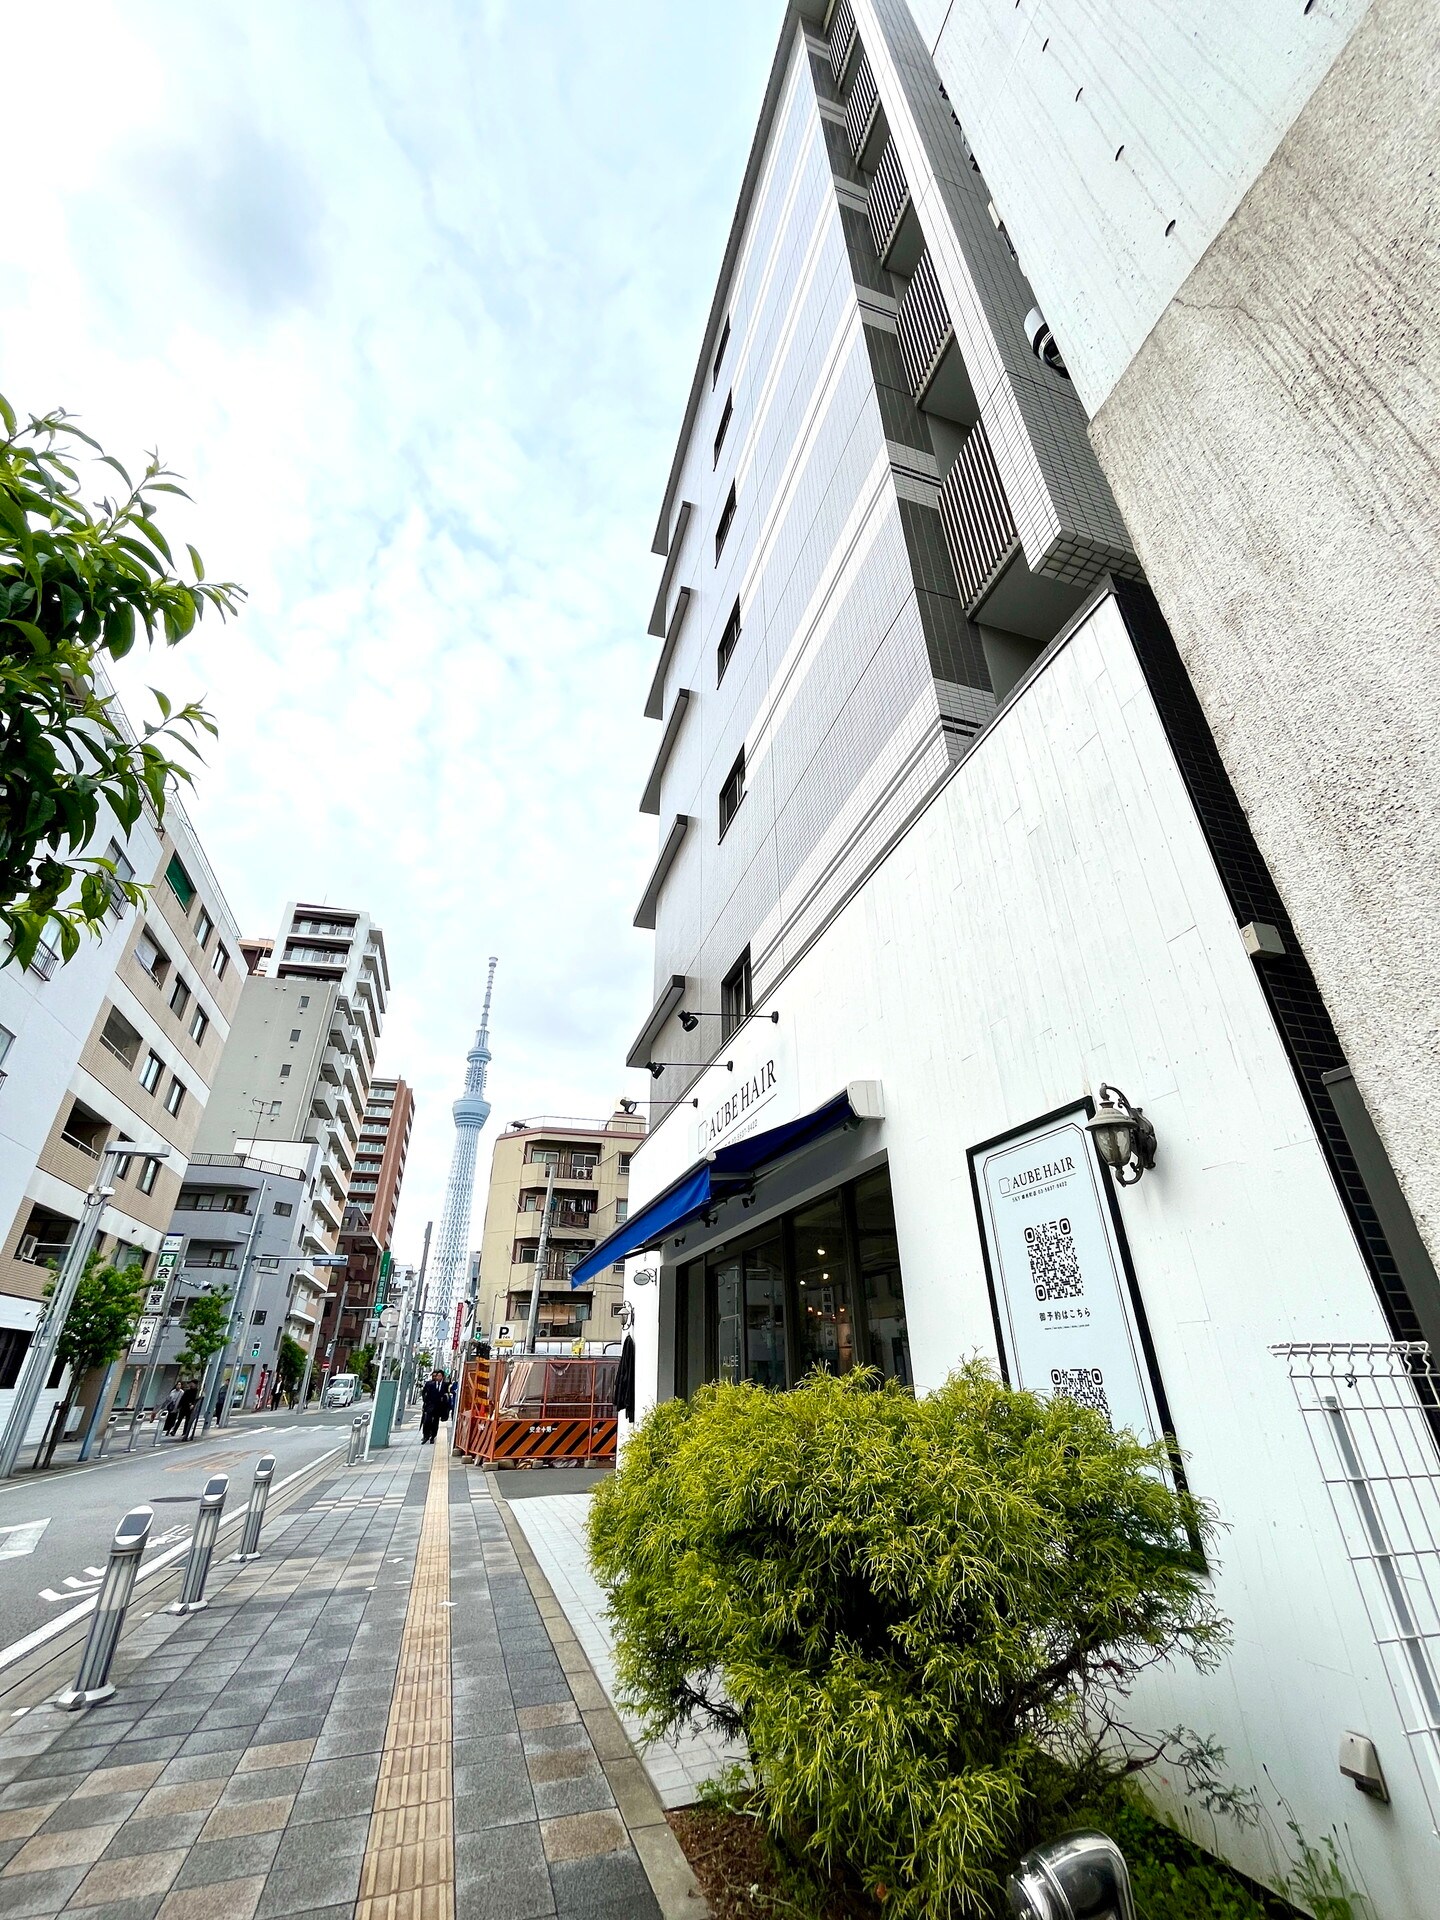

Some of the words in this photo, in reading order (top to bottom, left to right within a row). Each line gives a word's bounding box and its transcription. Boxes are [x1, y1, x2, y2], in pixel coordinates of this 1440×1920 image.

[708, 1093, 738, 1141] AUBE
[740, 1059, 777, 1112] HAIR
[1012, 1167, 1042, 1189] AUBE
[1042, 1156, 1075, 1179] HAIR
[498, 1326, 510, 1339] P
